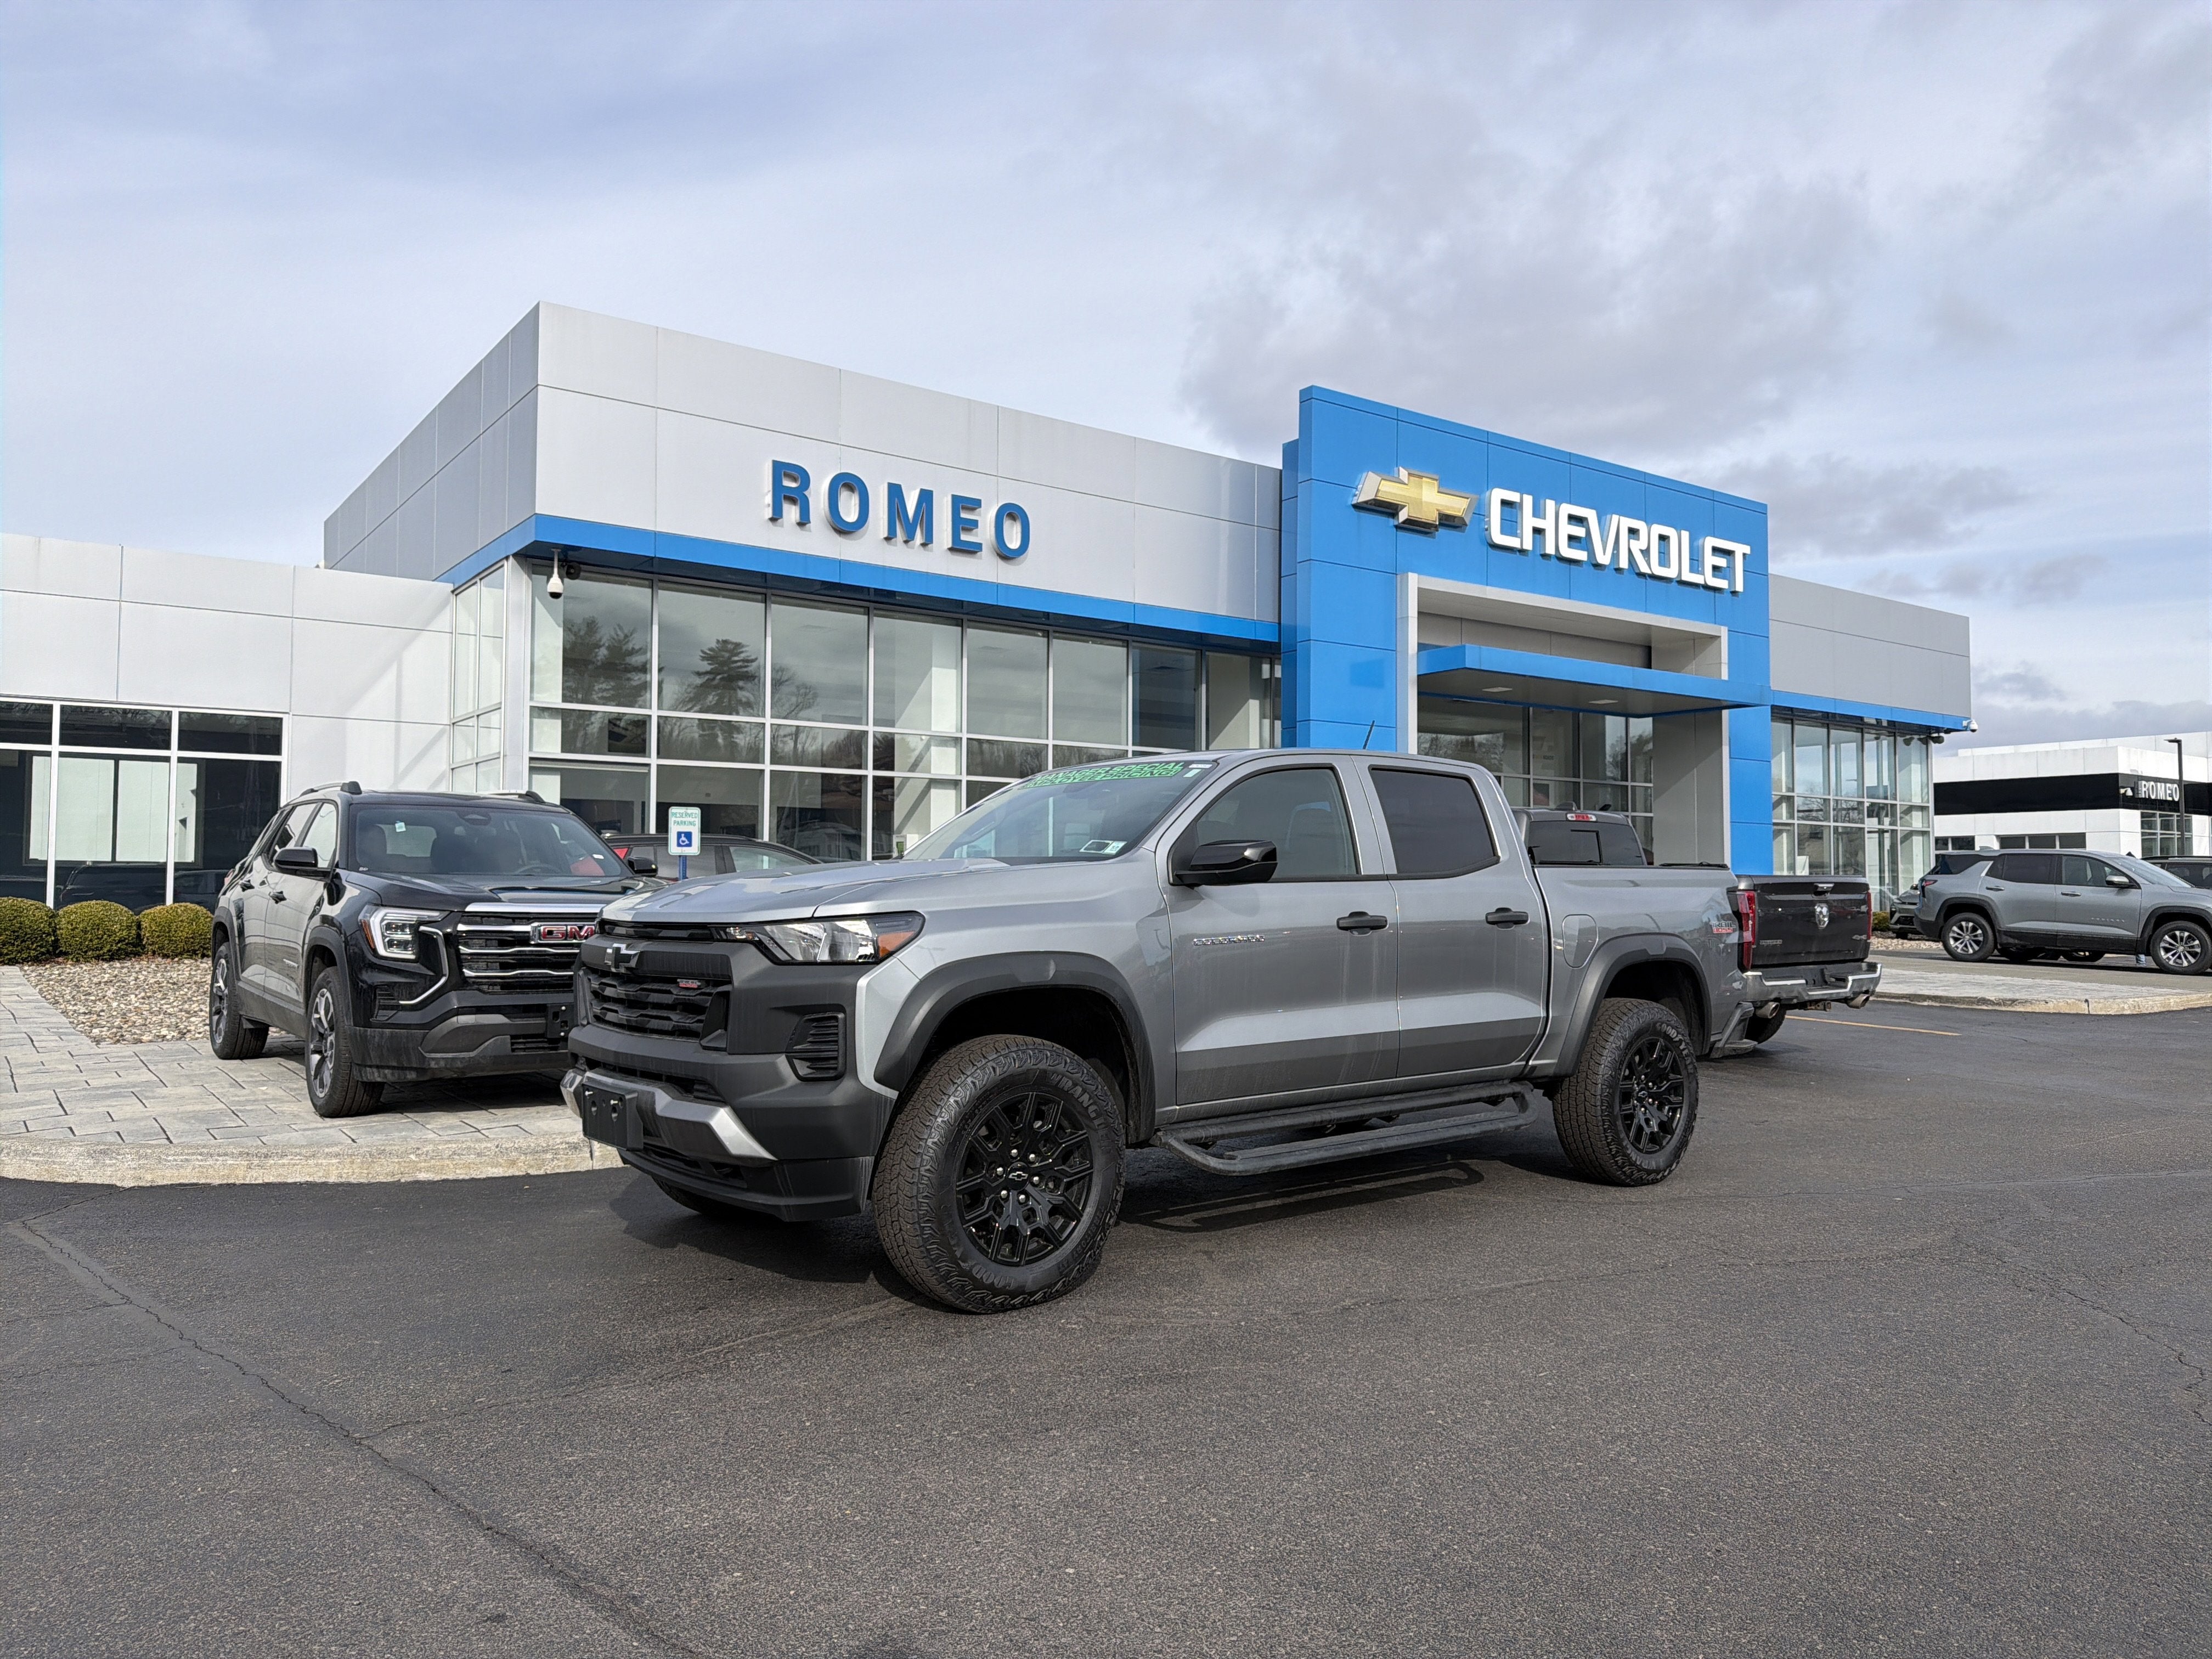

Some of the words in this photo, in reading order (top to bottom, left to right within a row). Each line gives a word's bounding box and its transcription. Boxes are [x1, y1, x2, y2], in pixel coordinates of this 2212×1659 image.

[770, 459, 1030, 558] ROMEO
[1487, 487, 1751, 593] CHEVROLET
[1024, 774, 1102, 787] EMPLOYEE
[1099, 769, 1178, 777] PRICING!
[1034, 768, 1110, 781] MANAGER
[1109, 762, 1184, 773] SPECIAL
[2141, 781, 2180, 802] ROMEO
[540, 926, 595, 940] GM
[1193, 934, 1265, 946] COLORADO
[1655, 1022, 1694, 1073] GOODYEAR
[1048, 1072, 1112, 1150] WRANGLER
